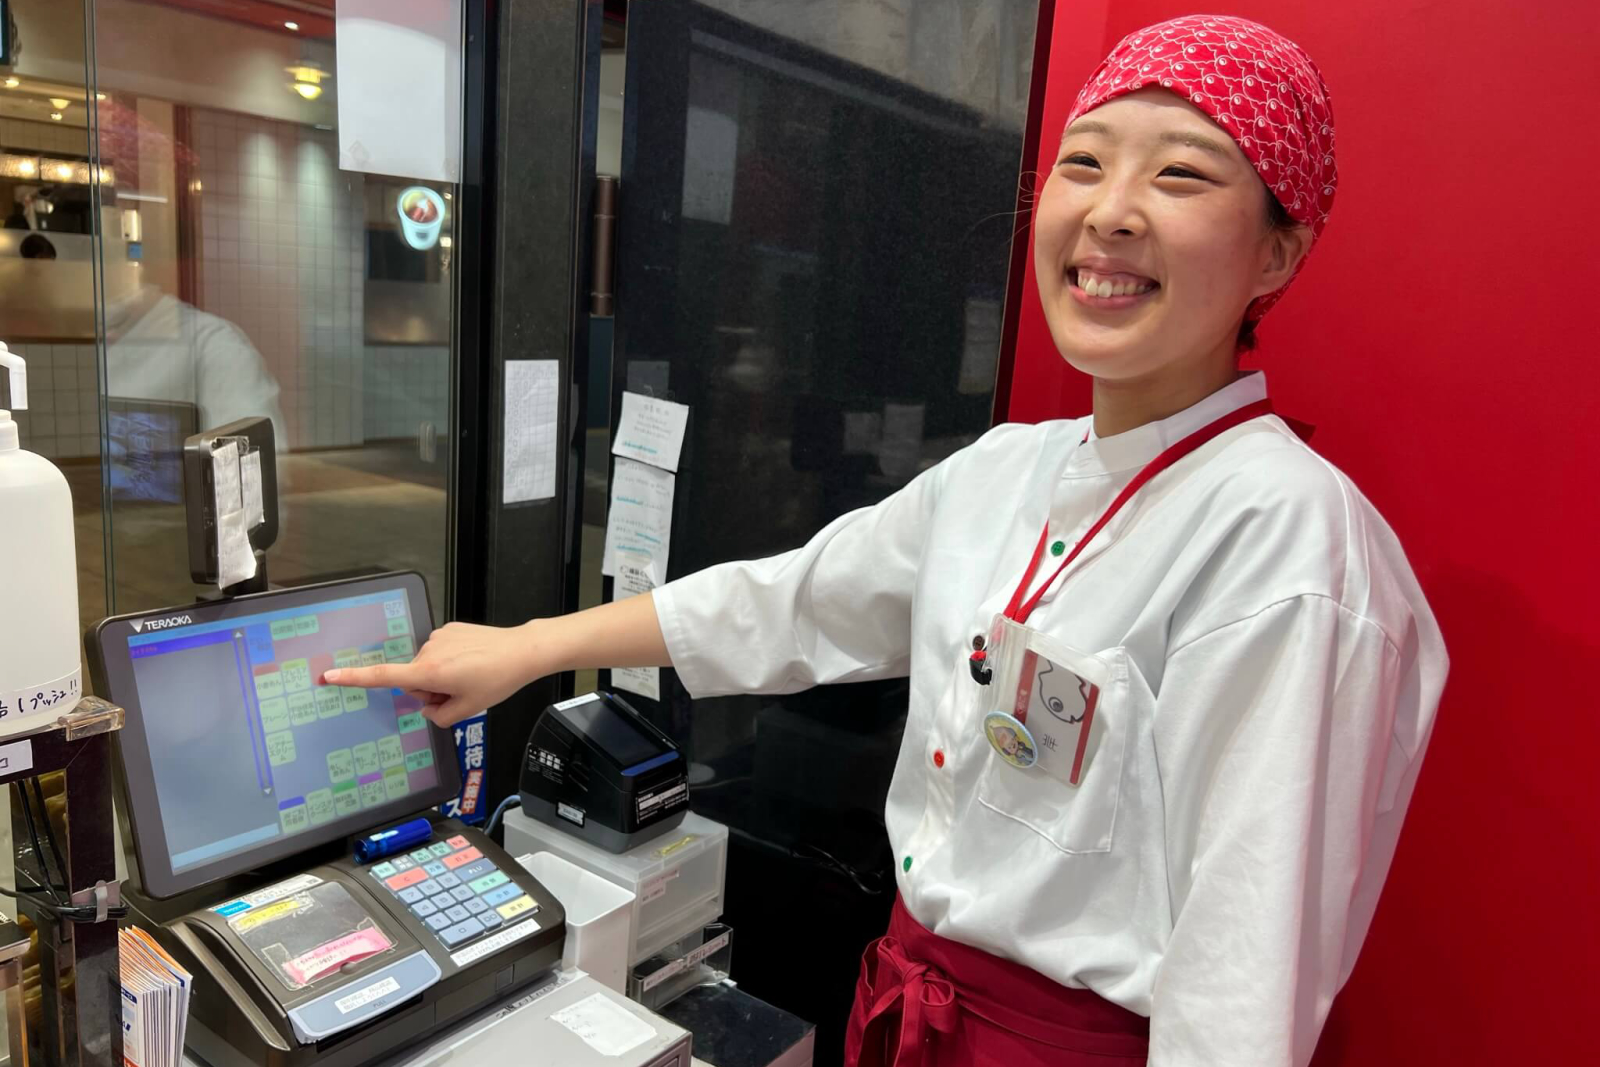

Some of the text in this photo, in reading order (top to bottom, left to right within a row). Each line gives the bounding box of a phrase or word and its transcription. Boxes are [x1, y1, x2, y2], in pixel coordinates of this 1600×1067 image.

[144, 615, 192, 630] TERAOKA
[465, 722, 484, 770] 優待
[1041, 733, 1060, 752] 岸
[463, 770, 482, 813] 実施中
[468, 865, 483, 875] PLU
